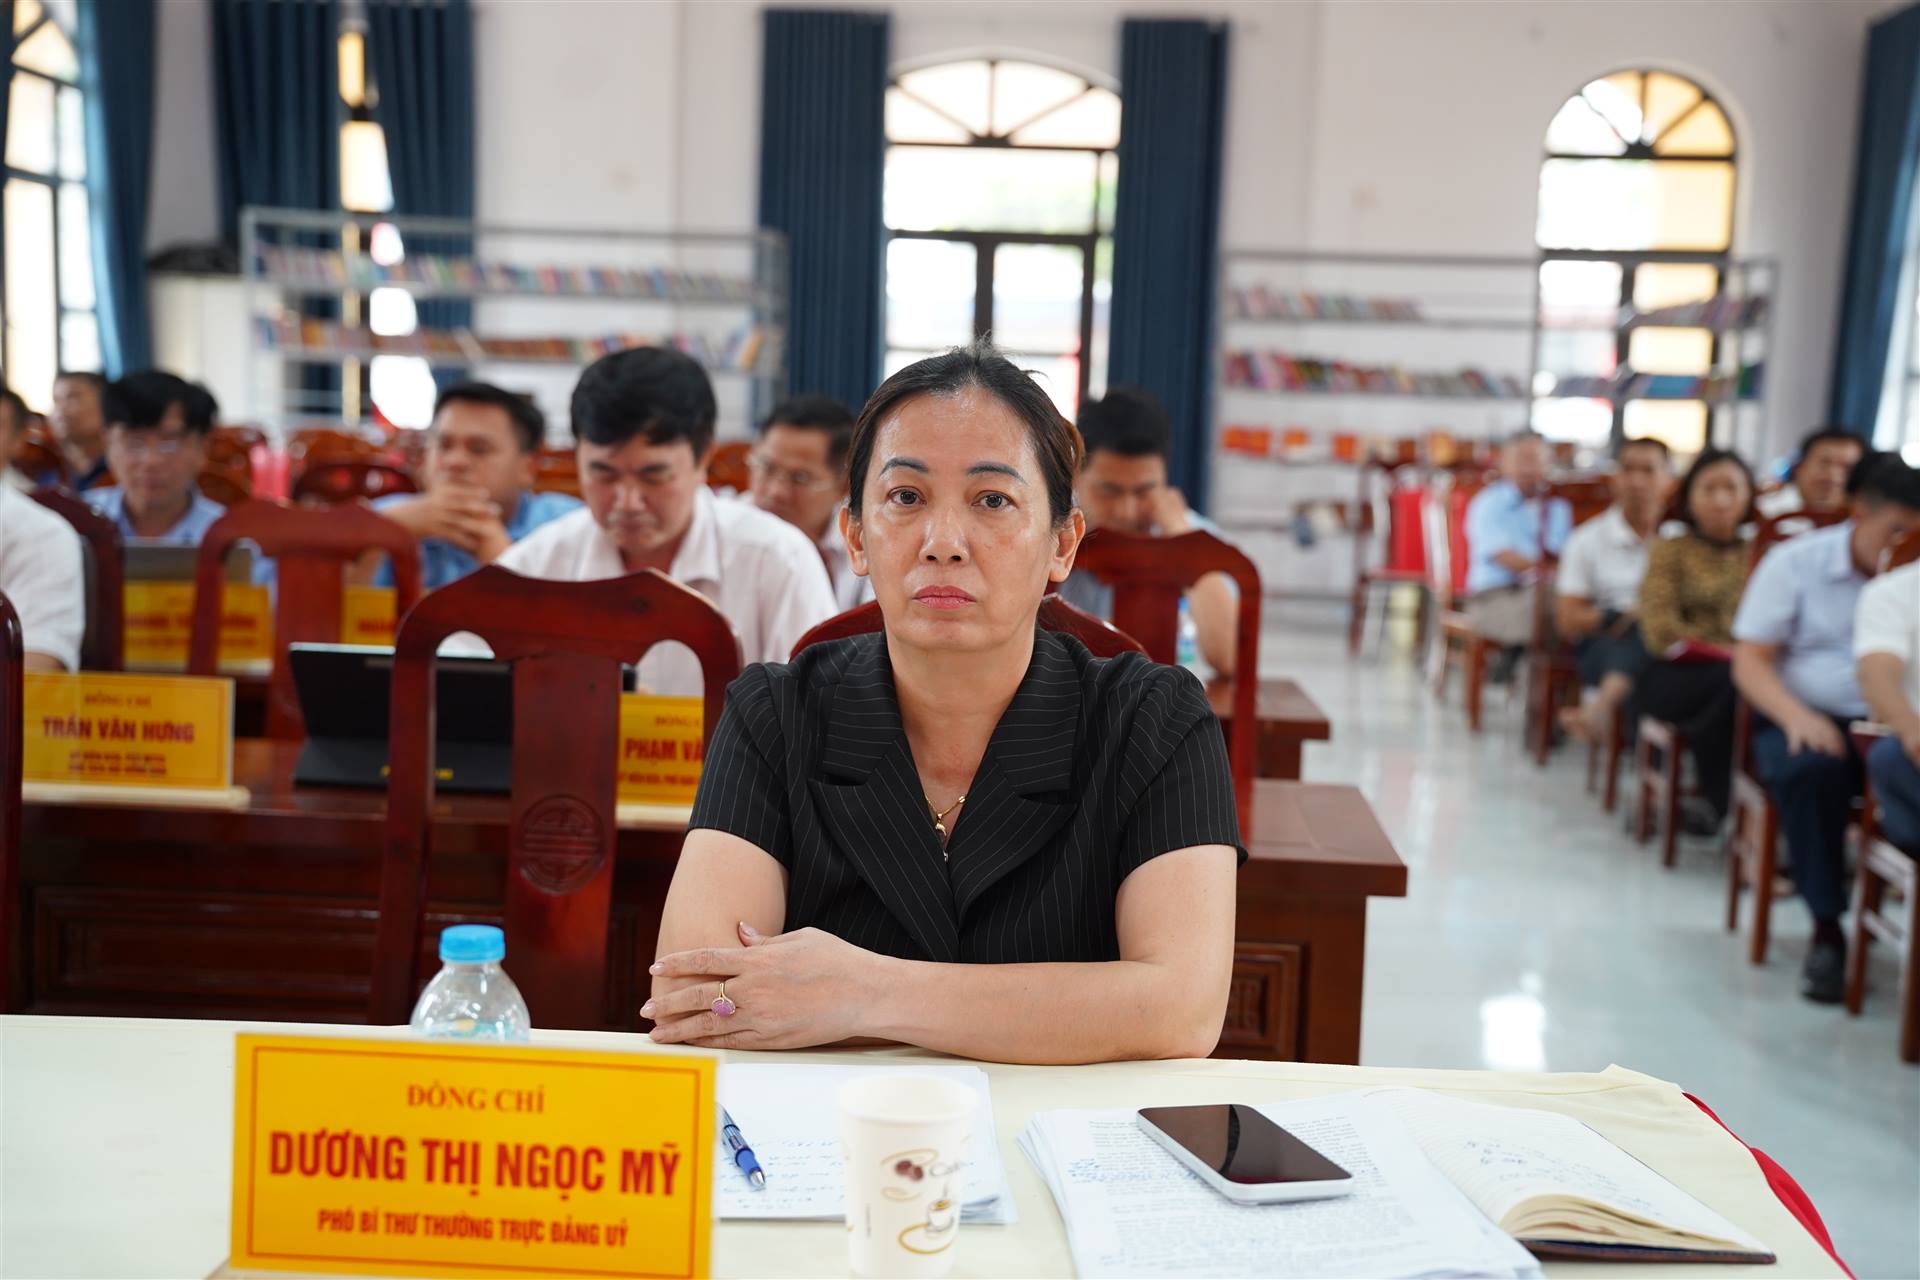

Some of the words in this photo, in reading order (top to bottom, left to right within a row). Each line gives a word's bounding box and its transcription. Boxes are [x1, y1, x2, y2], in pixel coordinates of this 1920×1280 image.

[98, 715, 136, 742] VĂN
[143, 719, 194, 743] HƯNG
[408, 1078, 487, 1111] ĐỒNG
[495, 1085, 545, 1114] CHÍ
[269, 1128, 406, 1181] DƯƠNG
[421, 1138, 480, 1196] THỊ
[497, 1142, 604, 1200] NGỌC
[620, 1142, 681, 1196] MỸ
[317, 1207, 354, 1232] PHÓ
[360, 1207, 378, 1233] BÍ
[384, 1211, 418, 1236] THƯ
[424, 1211, 493, 1240] THƯỜNG
[500, 1218, 544, 1247] TRỰC
[551, 1215, 599, 1246] ĐẢNG
